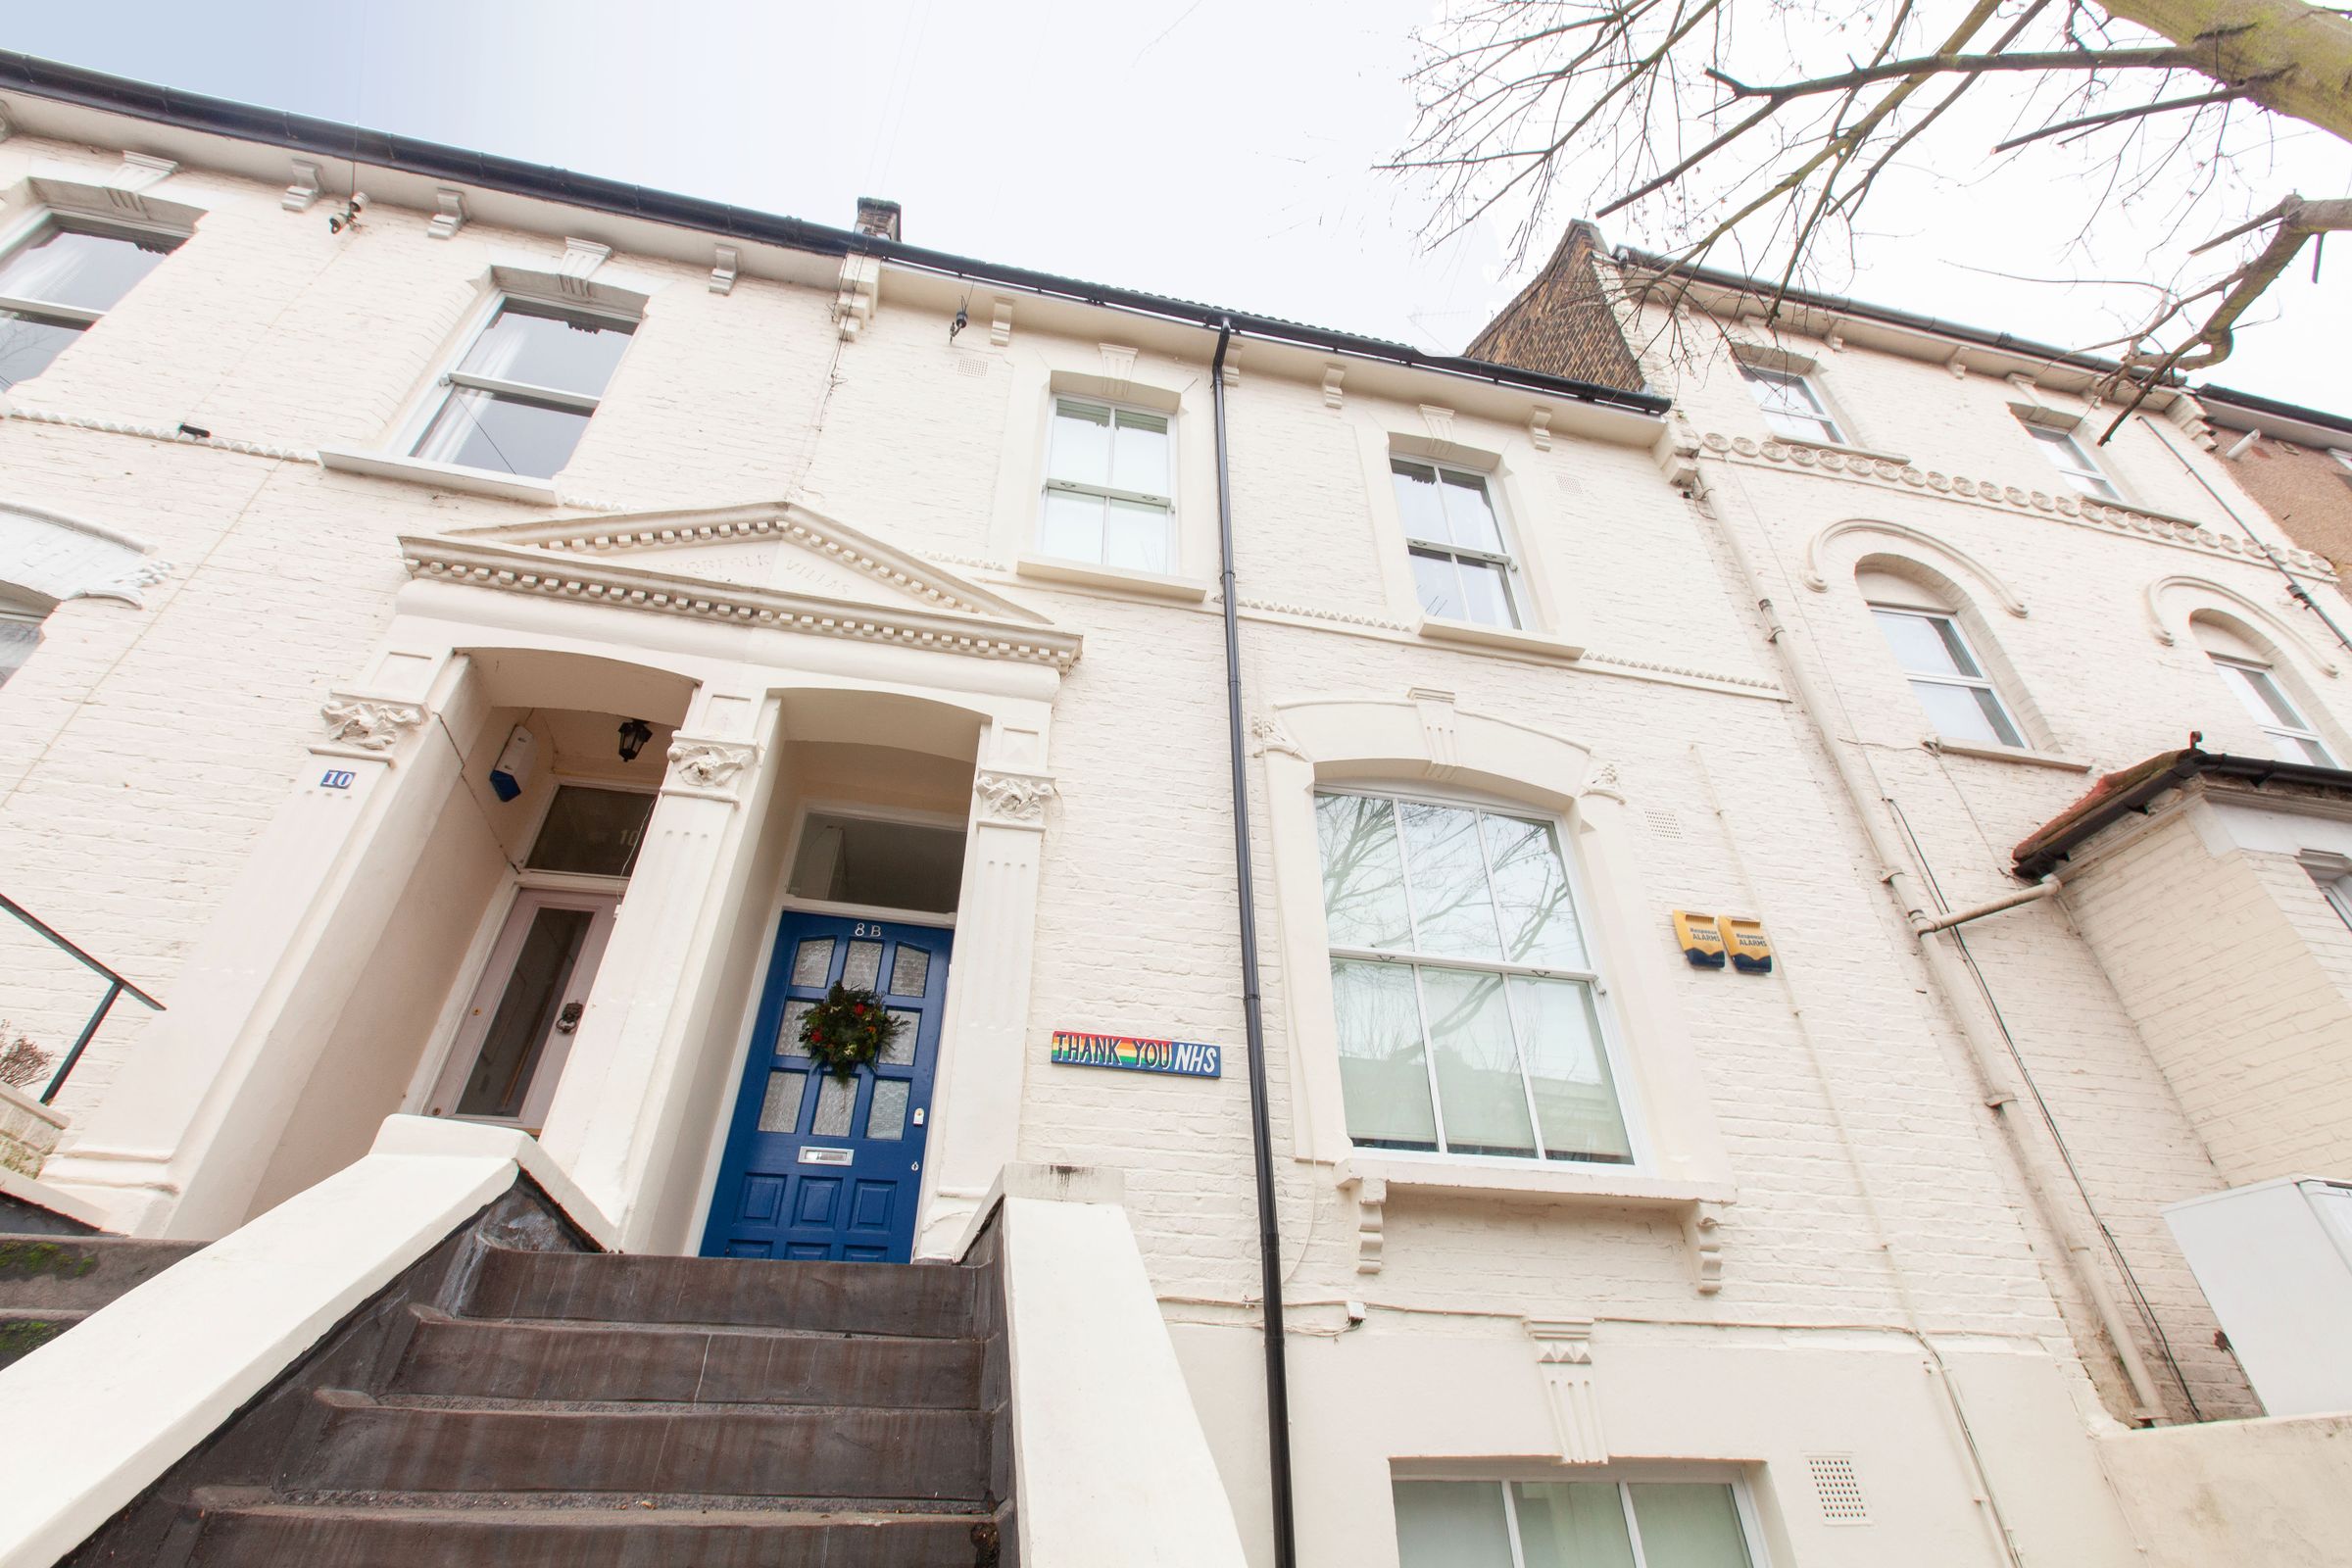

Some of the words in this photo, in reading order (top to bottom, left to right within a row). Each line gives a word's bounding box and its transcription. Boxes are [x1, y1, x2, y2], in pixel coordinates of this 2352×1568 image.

[670, 554, 770, 574] ORFOLK
[323, 771, 354, 786] 10
[619, 829, 639, 846] 10
[1692, 933, 1721, 942] ALARMS
[1055, 1034, 1123, 1066] THANK
[1132, 1040, 1173, 1070] YOU
[1174, 1044, 1217, 1073] NHS
